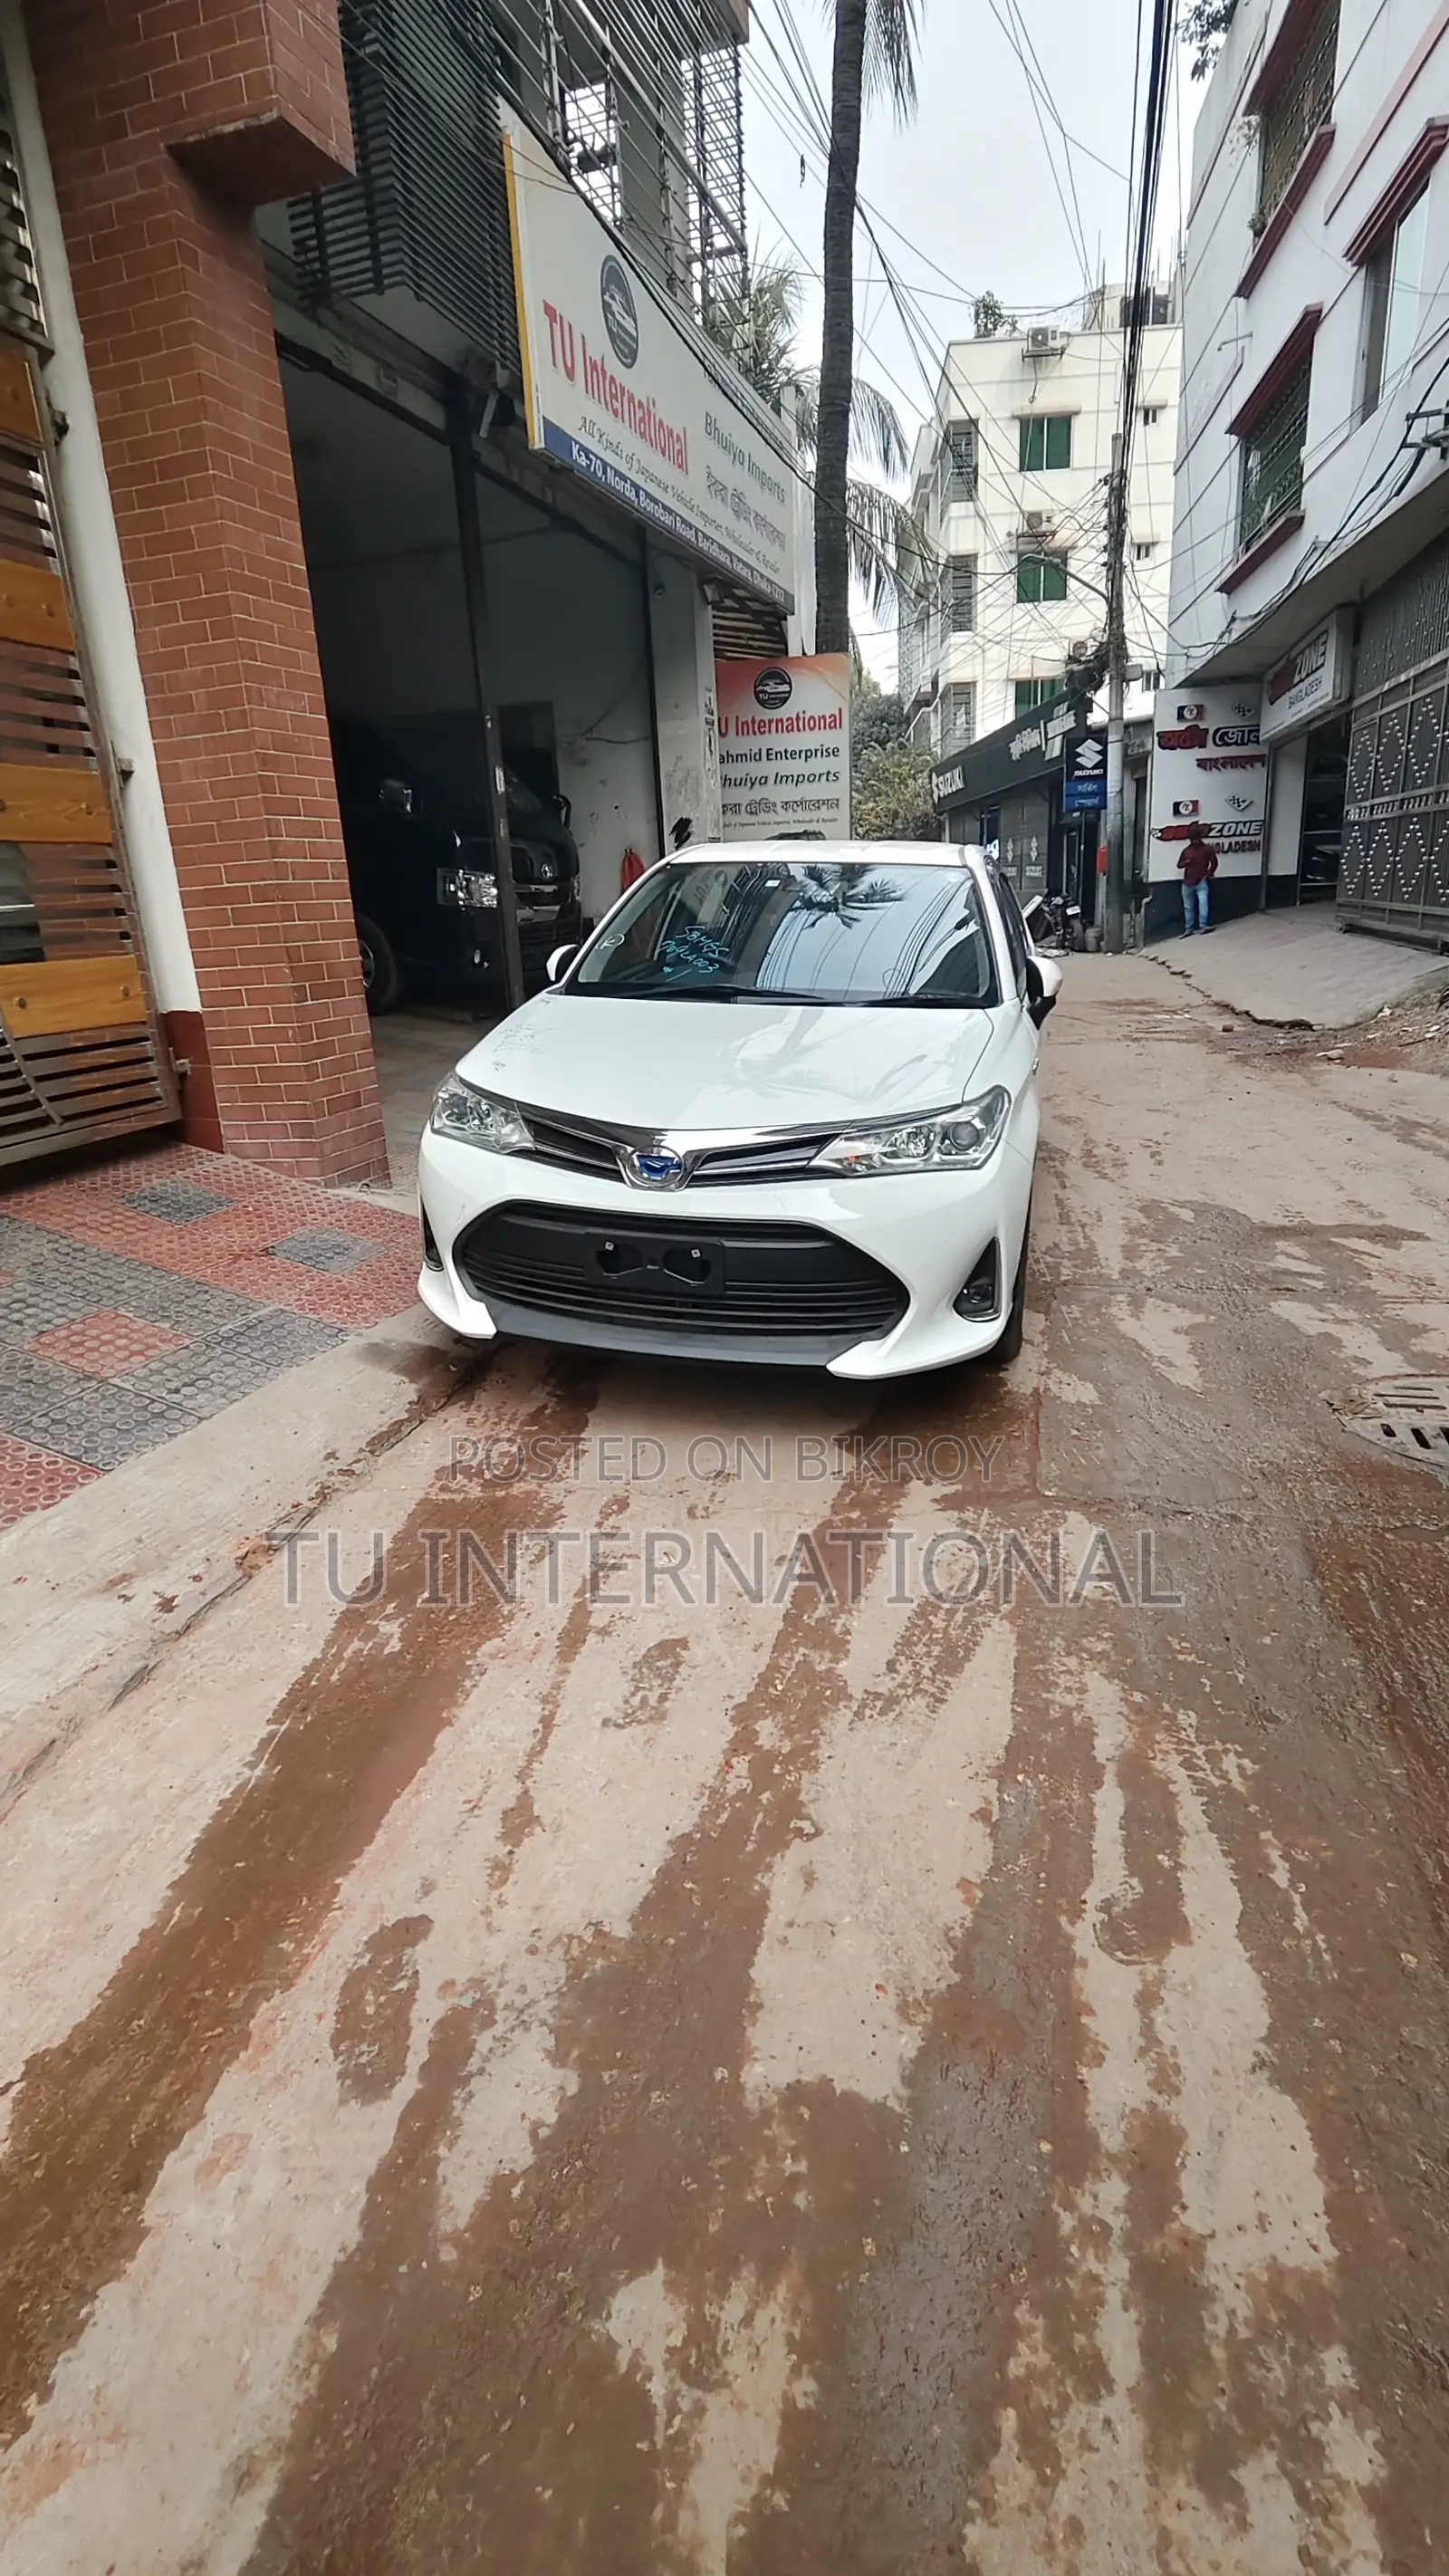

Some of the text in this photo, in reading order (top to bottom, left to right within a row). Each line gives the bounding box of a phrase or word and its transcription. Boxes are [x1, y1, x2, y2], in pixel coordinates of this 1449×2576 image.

[543, 300, 575, 381] TU
[581, 332, 688, 475] International
[579, 417, 596, 438] All
[597, 428, 623, 459] Kinds
[625, 452, 635, 470] of
[705, 411, 785, 504] Bhuiya Imports
[571, 440, 605, 483] Ka-70,
[607, 466, 638, 505] Norda,
[639, 490, 676, 529] Borobari
[676, 517, 696, 544] Road,
[1293, 629, 1329, 686] ZONE
[718, 707, 843, 738] U International
[719, 744, 840, 764] ahmid Enterprise
[721, 770, 840, 790] huiya Imports
[938, 766, 964, 798] SUZUKI
[1074, 768, 1103, 777] SUZUKI
[1208, 821, 1263, 837] ZONE
[1212, 840, 1261, 854] GLADESH
